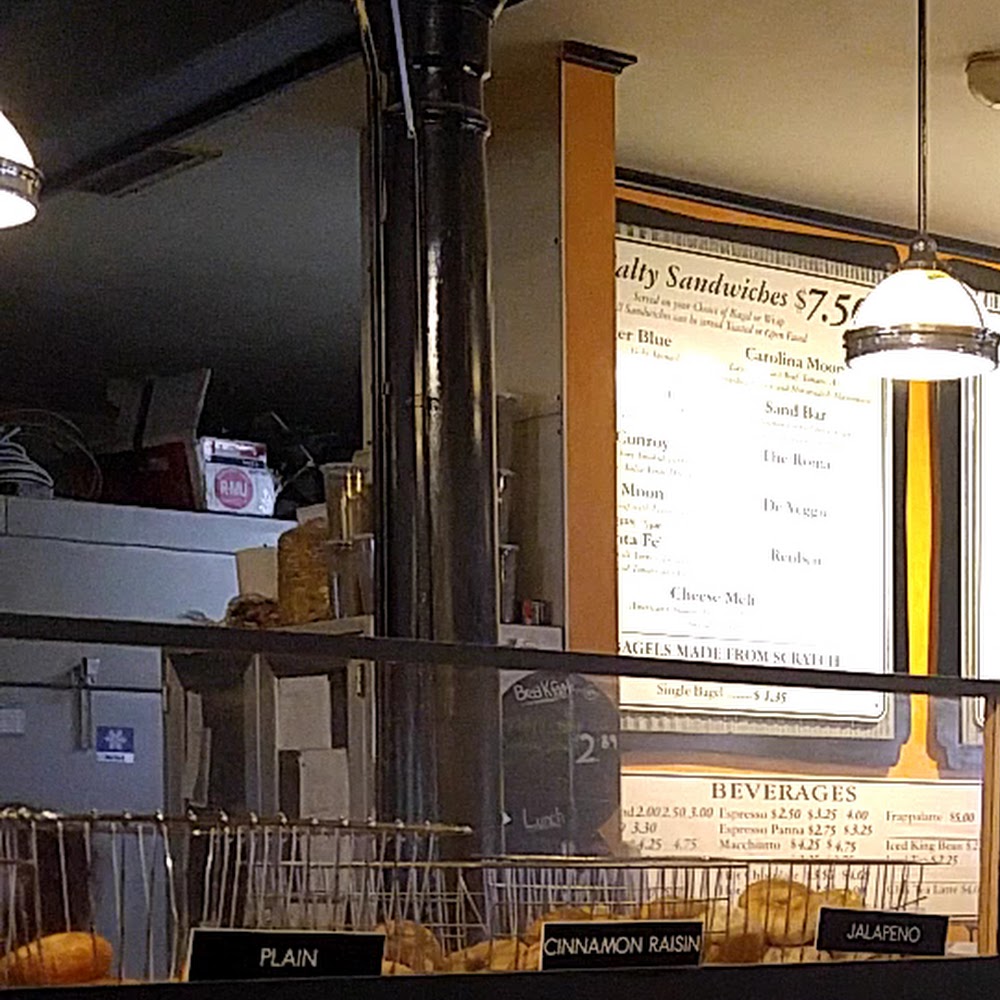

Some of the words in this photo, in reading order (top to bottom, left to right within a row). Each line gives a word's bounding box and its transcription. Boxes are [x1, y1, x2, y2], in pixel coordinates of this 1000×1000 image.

[666, 264, 788, 307] Sandwiches
[638, 328, 672, 348] Blue
[745, 347, 803, 370] Carolina
[764, 401, 799, 419] Sand
[802, 405, 827, 422] Bar
[621, 483, 664, 501] Moon
[617, 640, 672, 656] AGELS
[676, 644, 722, 661] MADE
[726, 647, 769, 664] FROM
[773, 650, 841, 669] SCRATCH
[656, 683, 692, 698] Single
[693, 684, 724, 698] Bagel
[711, 782, 858, 803] BEVERAGES
[522, 806, 566, 830] Lunch
[719, 807, 768, 821] Espresso
[719, 823, 768, 837] Espresso
[886, 839, 909, 851] Iced
[846, 922, 921, 944] JALAPENO
[543, 936, 644, 959] CINNAMON
[648, 934, 701, 953] RAISIN
[259, 947, 319, 968] PLAIN
